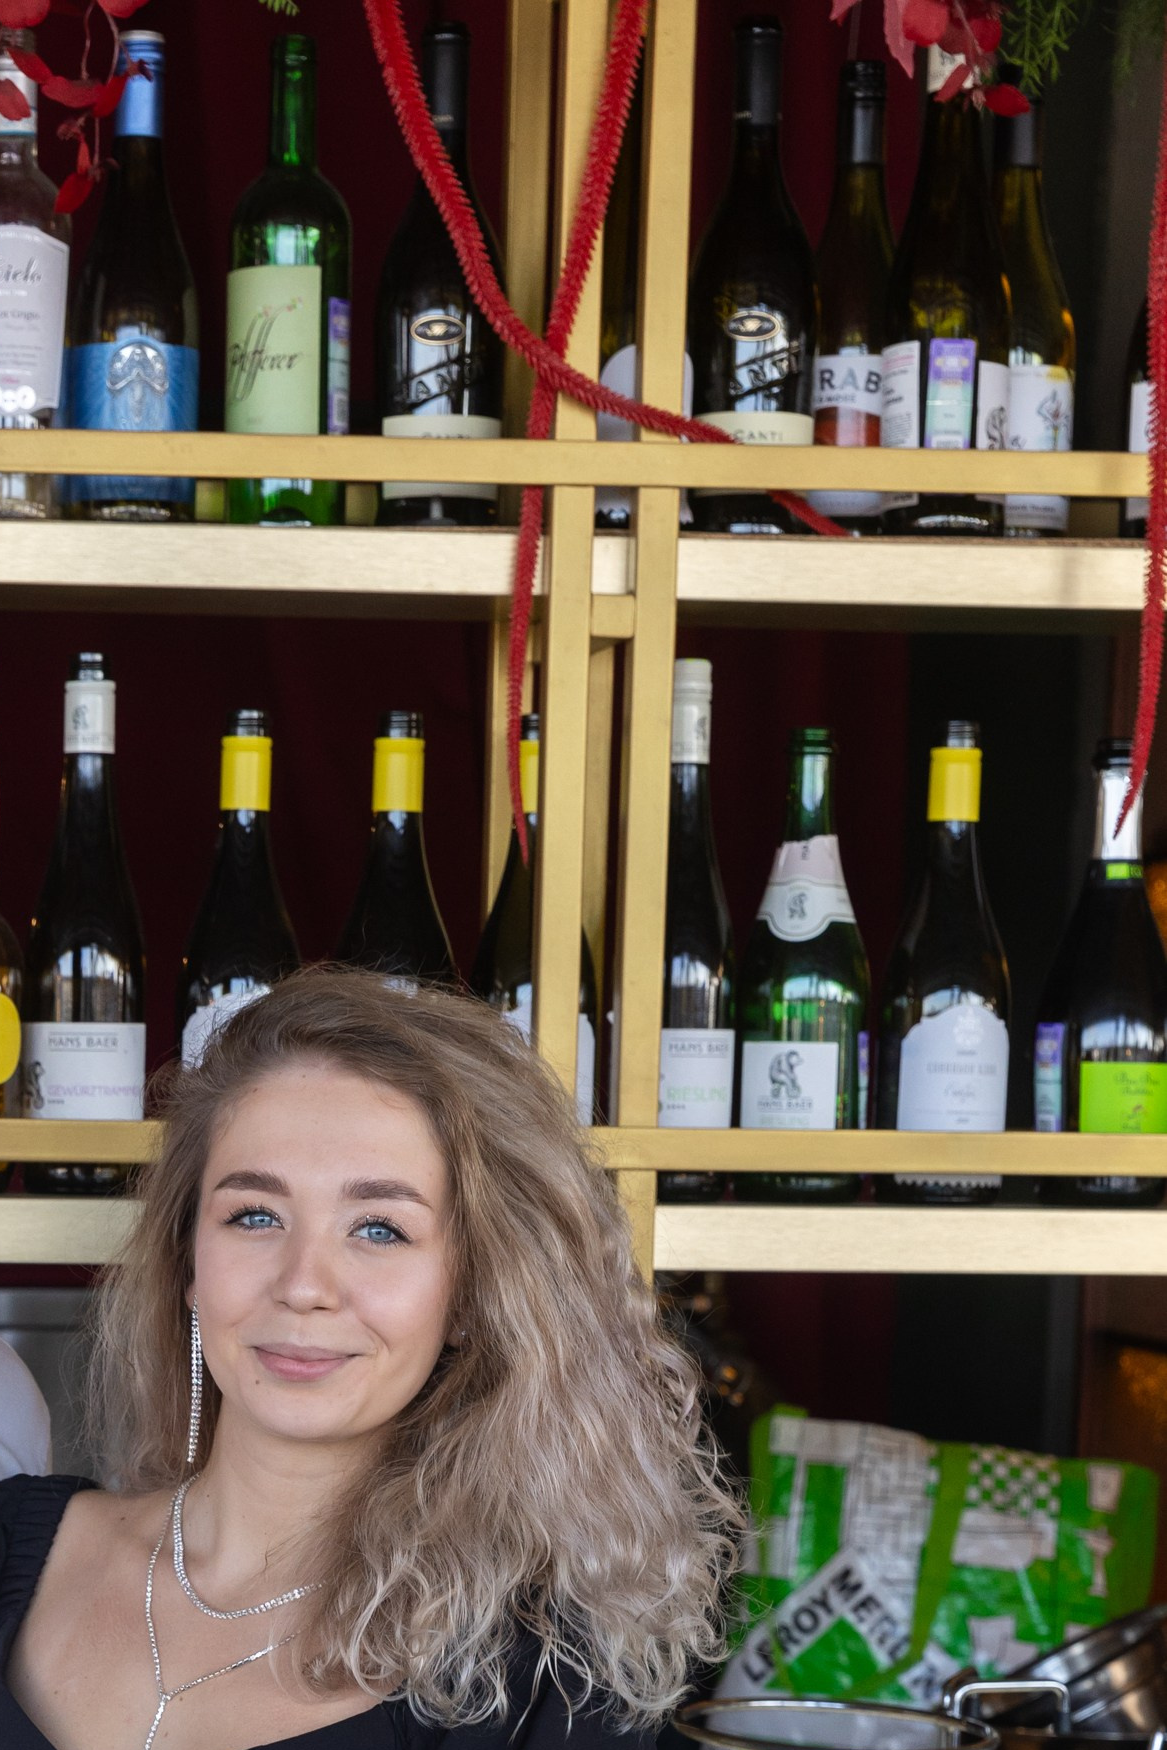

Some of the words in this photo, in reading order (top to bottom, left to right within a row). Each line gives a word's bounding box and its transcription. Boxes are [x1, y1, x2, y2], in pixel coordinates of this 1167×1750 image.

[735, 429, 783, 442] CANTI
[48, 1037, 81, 1048] HANS
[86, 1037, 119, 1048] BAER
